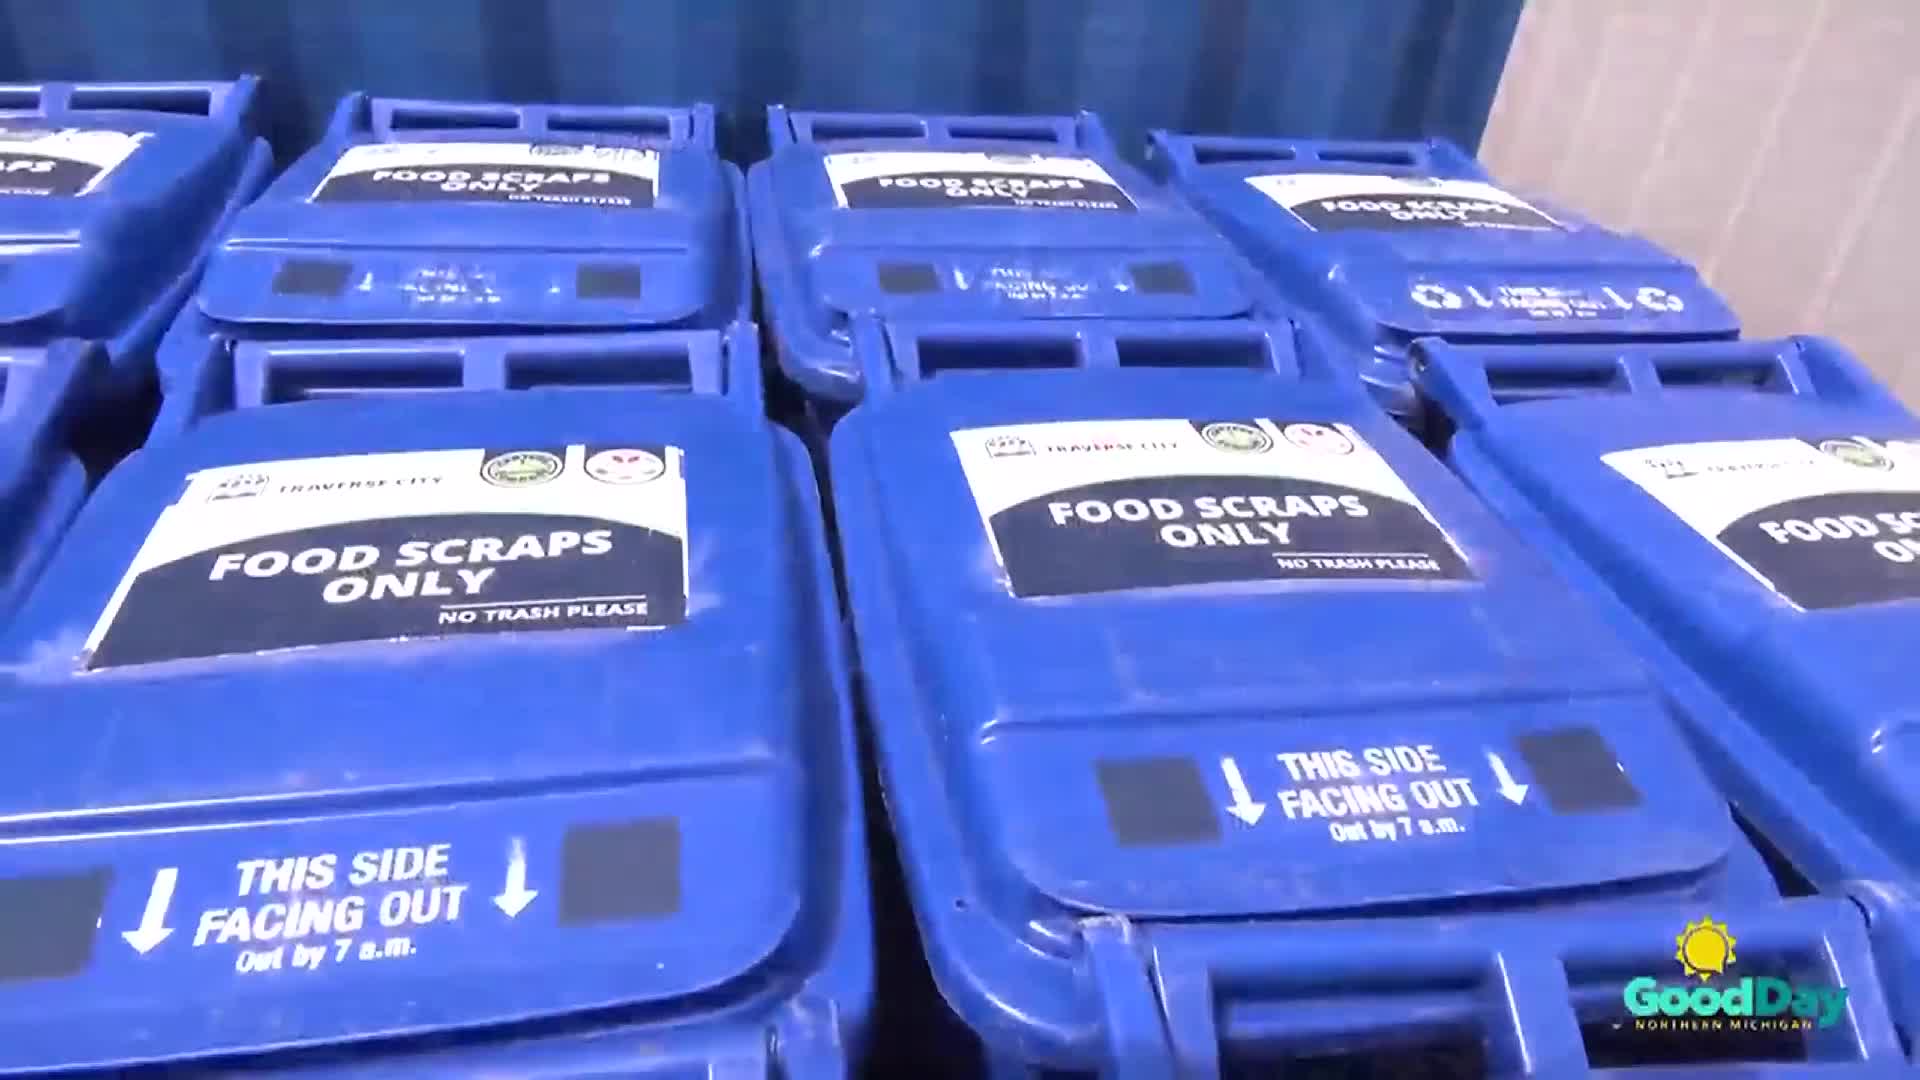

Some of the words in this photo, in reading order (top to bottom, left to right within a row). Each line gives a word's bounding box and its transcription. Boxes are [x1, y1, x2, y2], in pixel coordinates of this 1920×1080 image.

[372, 170, 471, 182] FOOD
[440, 181, 540, 192] ONLY
[879, 177, 963, 188] FOOD
[1048, 496, 1184, 526] FOOD
[1194, 494, 1370, 521] SCRAPS
[1160, 520, 1294, 549] ONLY
[1758, 514, 1880, 545] FOOD
[208, 545, 380, 581] FOOD
[395, 530, 613, 567] SCRAPS
[1277, 558, 1309, 570] NO
[1310, 558, 1374, 570] TRASH
[1375, 557, 1442, 572] PLEASE
[322, 568, 496, 604] ONLY
[438, 610, 478, 625] NO
[484, 606, 561, 623] TRASH
[566, 601, 649, 620] PLEASE
[1276, 750, 1361, 781] THIS
[1363, 744, 1447, 776] SIDE
[1277, 784, 1408, 818] FACING
[1409, 778, 1480, 809] OUT
[1397, 816, 1412, 836] 7
[236, 853, 337, 896] THIS
[348, 843, 452, 886] SIDE
[192, 896, 366, 946] FACING
[379, 882, 468, 927] OUT
[235, 946, 284, 973] Out
[291, 943, 327, 970] by
[335, 938, 353, 962] 7
[358, 937, 417, 960] a.m.
